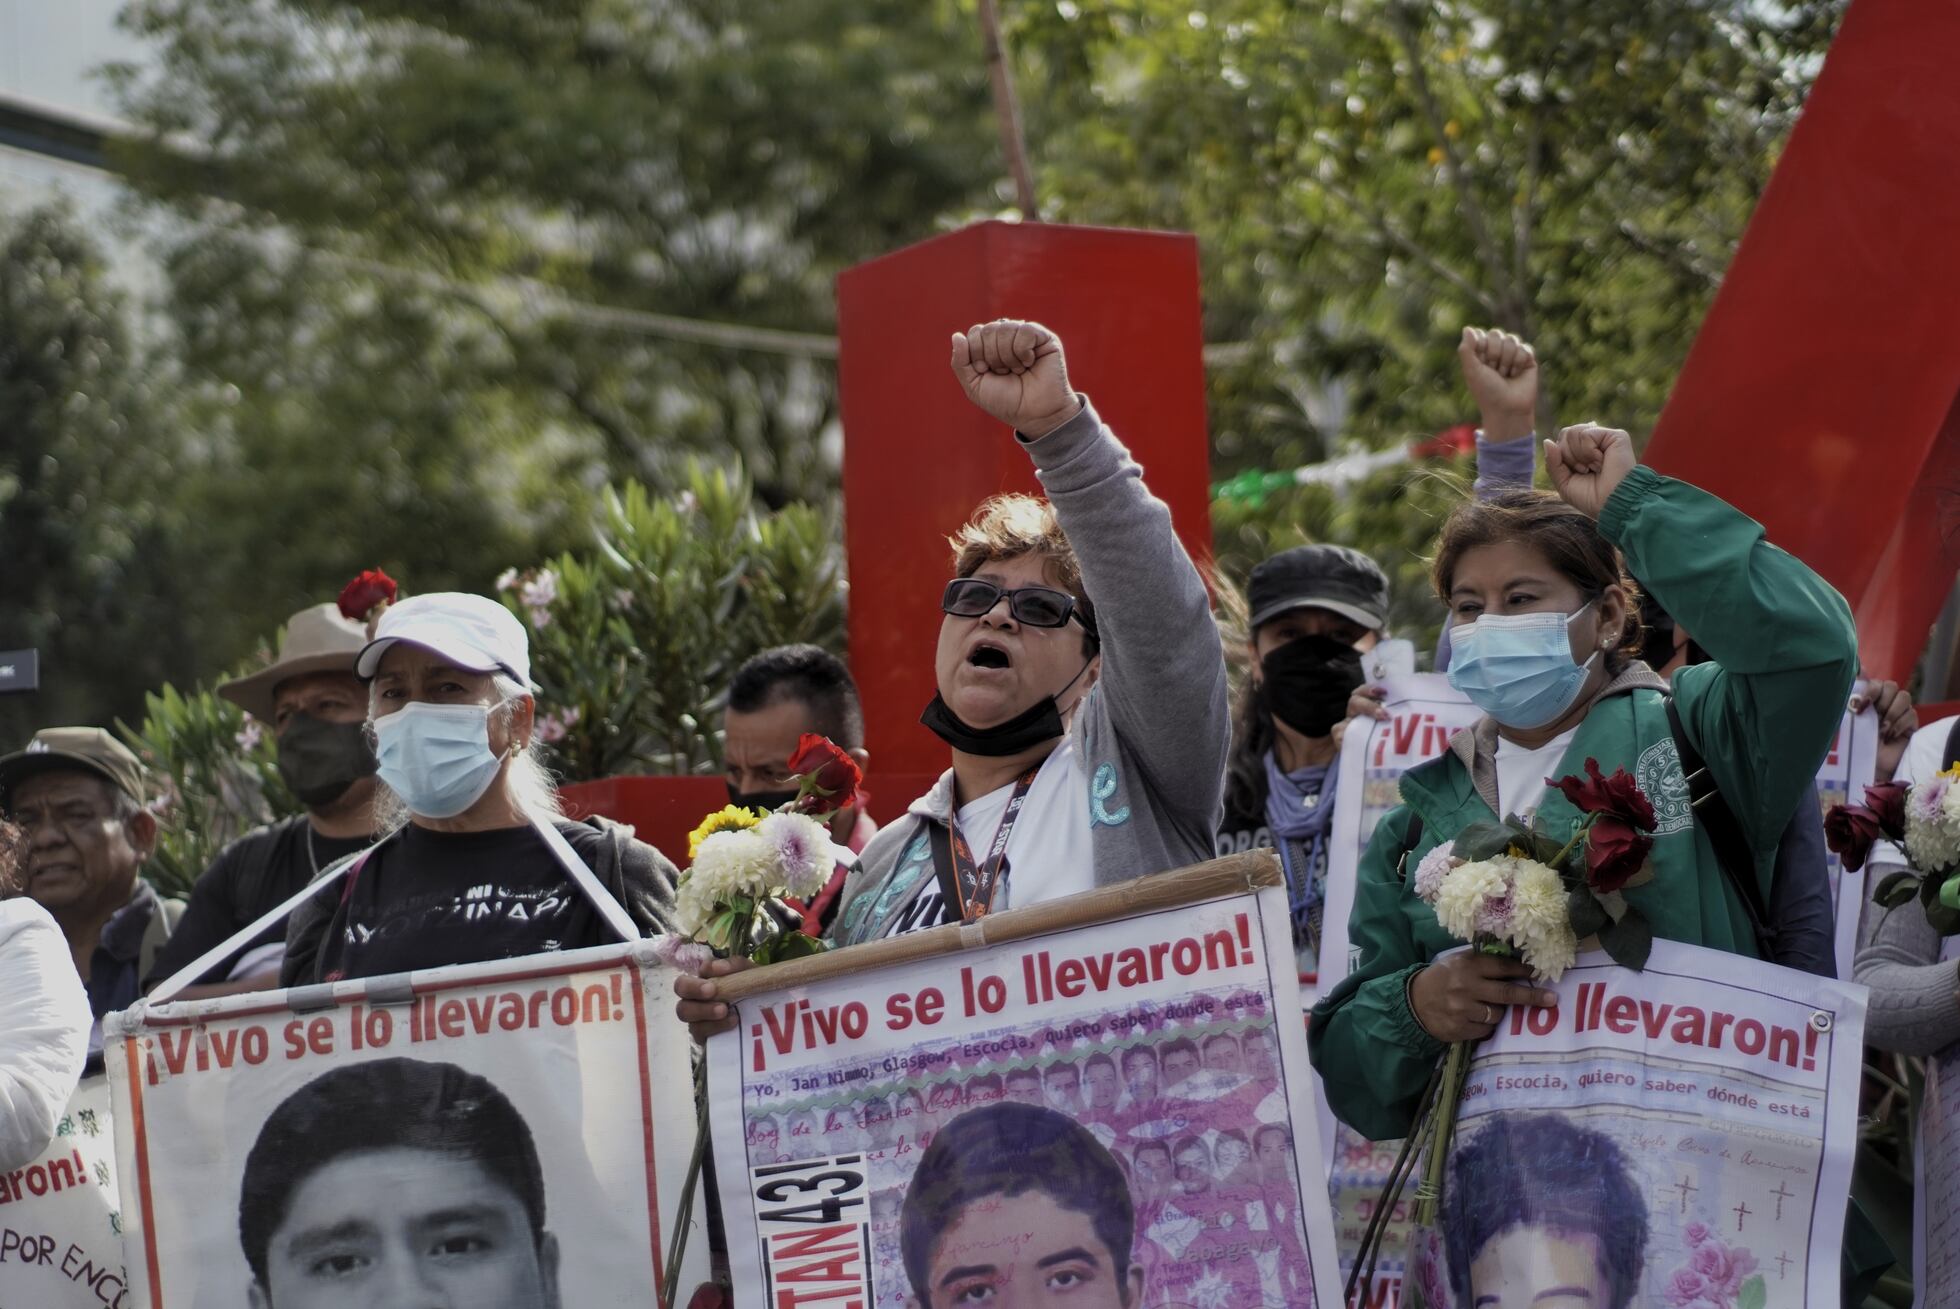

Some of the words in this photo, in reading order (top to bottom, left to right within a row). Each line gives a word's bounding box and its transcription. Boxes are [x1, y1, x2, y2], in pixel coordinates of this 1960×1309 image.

[146, 1022, 269, 1086] ¡Vivo
[283, 1016, 334, 1060] se
[351, 1005, 393, 1050] lo
[410, 973, 625, 1043] llevaron!
[751, 998, 869, 1072] ¡Vivo
[885, 986, 945, 1031] se
[960, 966, 1008, 1018] lo
[1021, 912, 1255, 1006] llevaron!
[1574, 981, 1821, 1072] llevaron!
[754, 1083, 780, 1097] Yo,
[792, 1077, 820, 1092] Jan
[827, 1066, 876, 1088] Nimmo,
[882, 1051, 953, 1075] Glasgow,
[963, 1036, 1036, 1058] Escocia,
[1045, 1022, 1101, 1045] quiero
[1110, 1012, 1156, 1031] saber
[1165, 999, 1215, 1021] dónde
[1223, 991, 1264, 1011] está
[1495, 1075, 1569, 1091] Escocia,
[1578, 1069, 1636, 1089] quiero
[1644, 1080, 1697, 1094] saber
[1706, 1085, 1759, 1110] dónde
[1768, 1100, 1811, 1119] está
[755, 1155, 864, 1223] 43!
[771, 1222, 863, 1309] TAN
